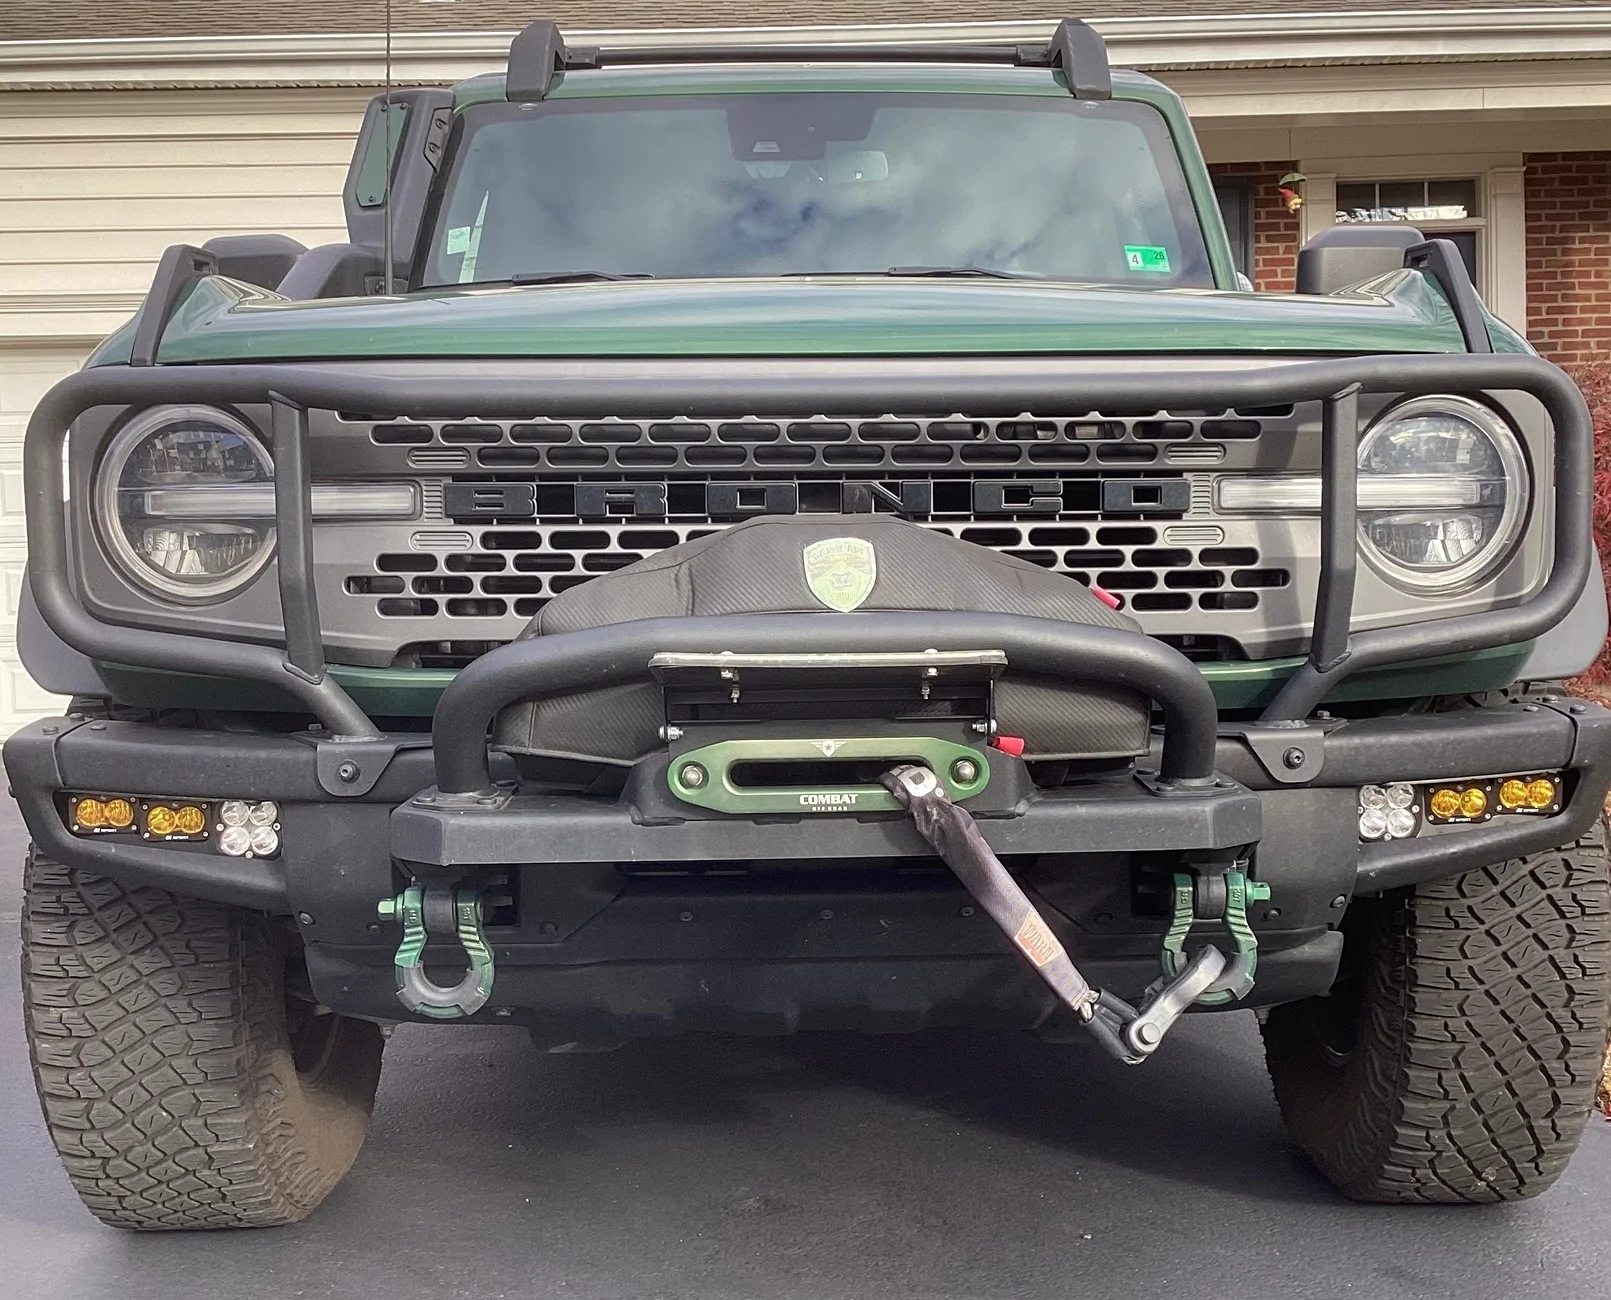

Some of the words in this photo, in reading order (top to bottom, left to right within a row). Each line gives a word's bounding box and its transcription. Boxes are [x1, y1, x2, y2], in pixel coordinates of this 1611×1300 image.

[1132, 254, 1139, 264] 4
[445, 480, 1191, 517] BRONCO
[800, 793, 859, 805] COMBAT
[1023, 922, 1055, 960] WARN
